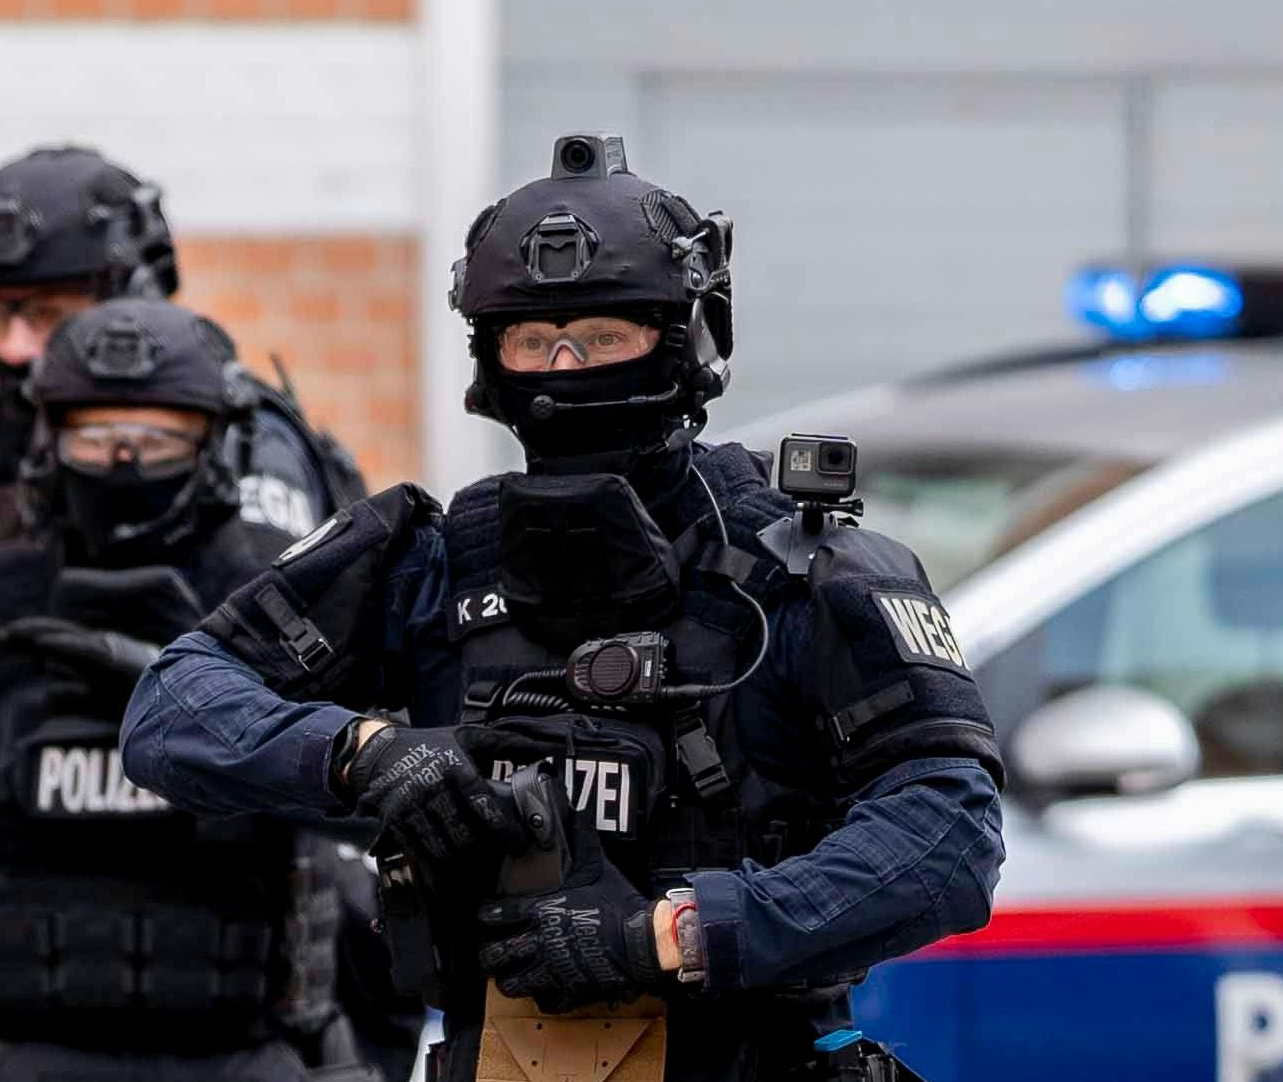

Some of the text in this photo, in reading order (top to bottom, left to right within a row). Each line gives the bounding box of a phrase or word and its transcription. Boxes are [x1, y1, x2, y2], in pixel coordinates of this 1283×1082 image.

[238, 474, 316, 539] EGA
[457, 597, 472, 625] K
[38, 747, 168, 813] POLI
[491, 756, 630, 832] IZEI
